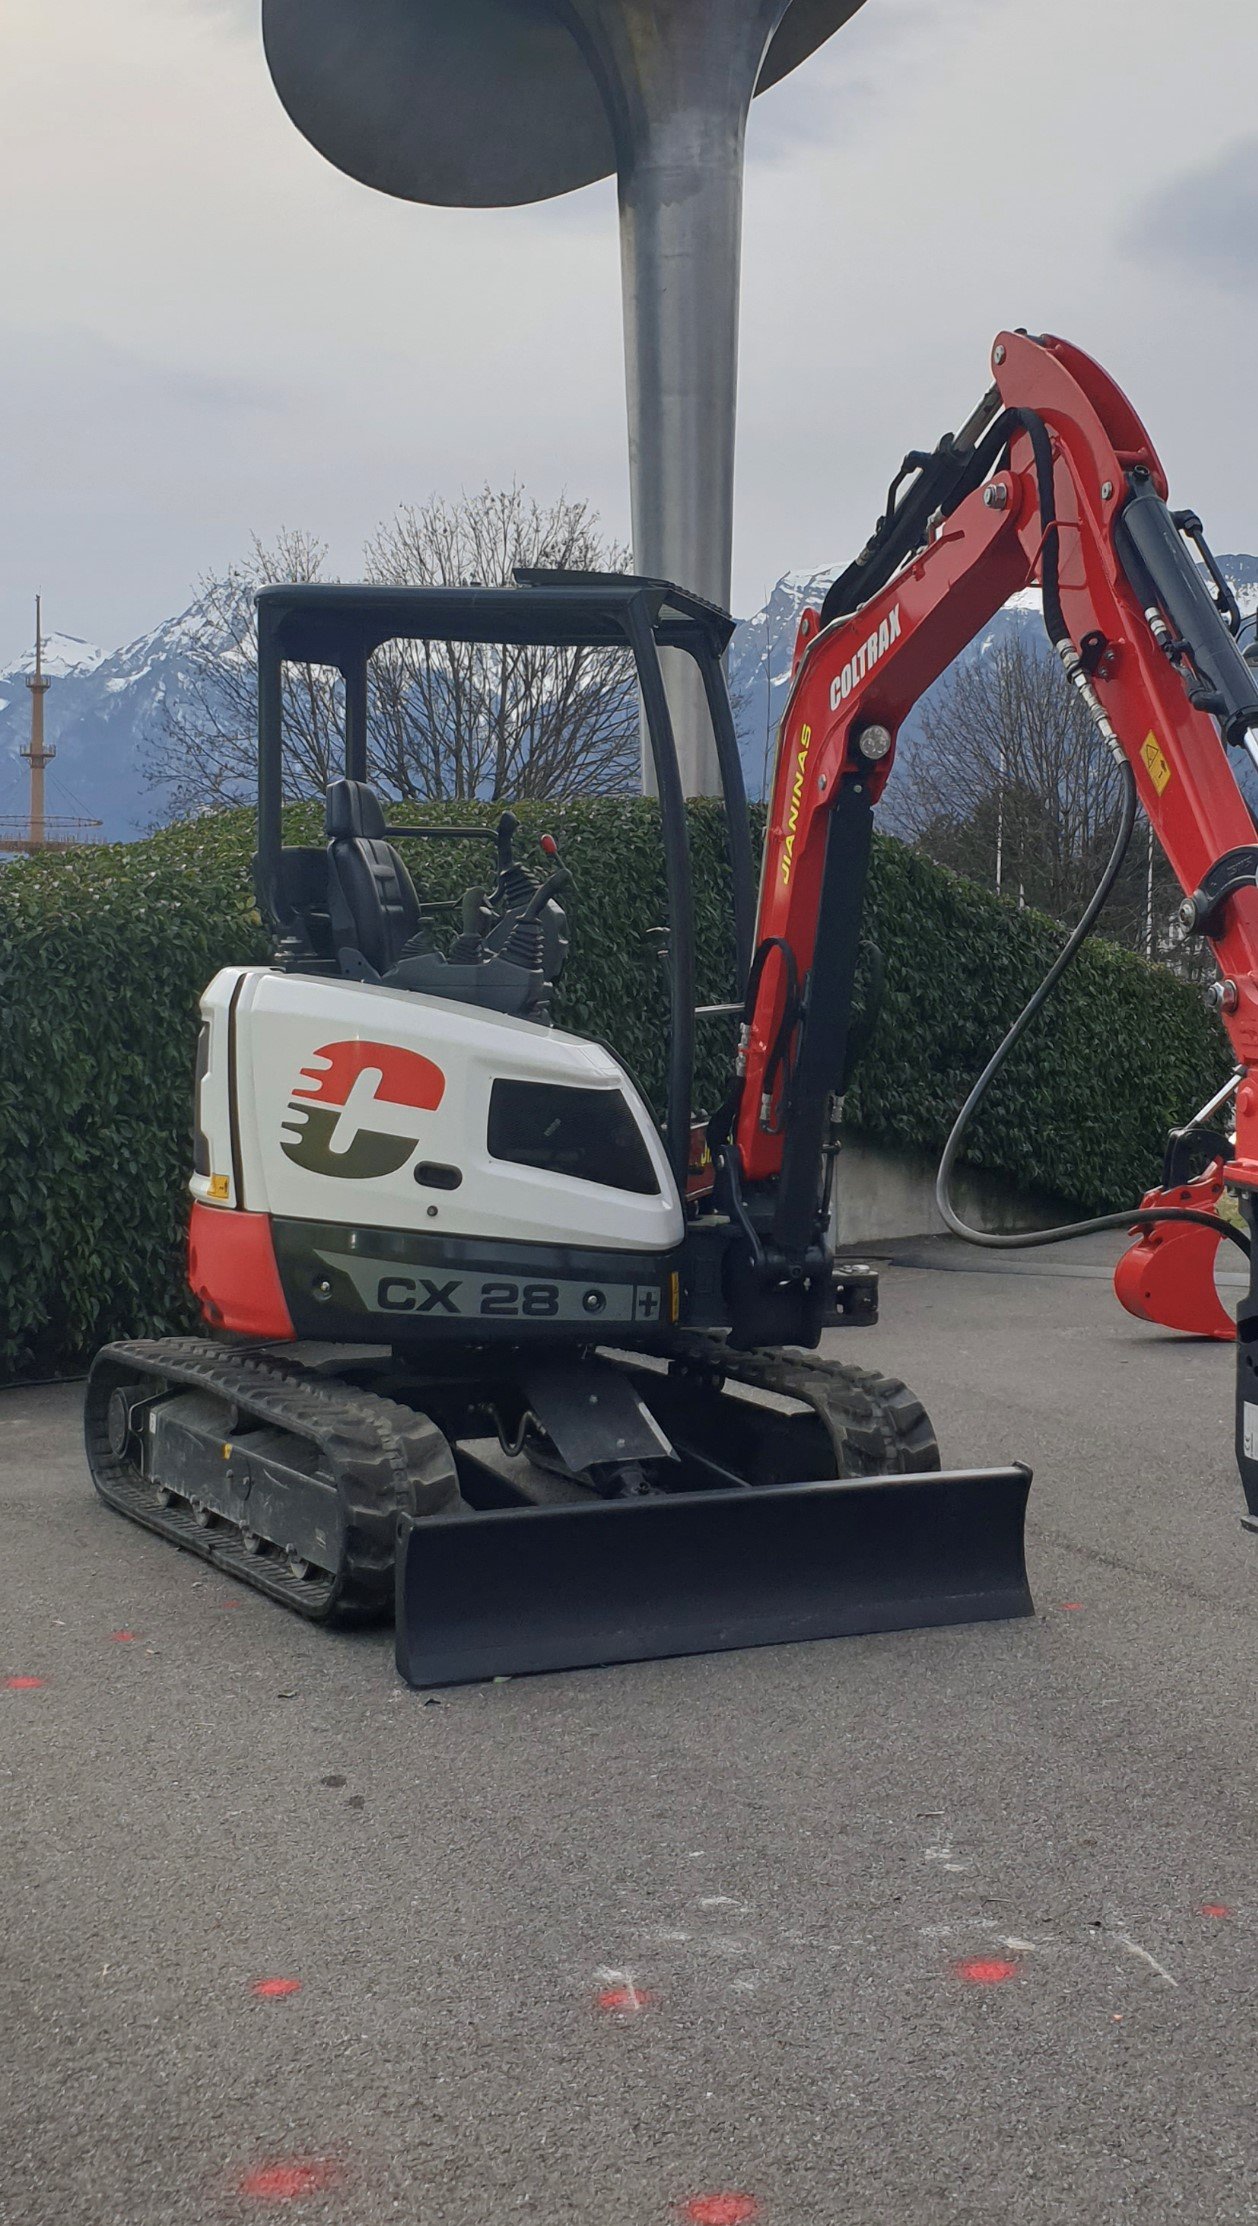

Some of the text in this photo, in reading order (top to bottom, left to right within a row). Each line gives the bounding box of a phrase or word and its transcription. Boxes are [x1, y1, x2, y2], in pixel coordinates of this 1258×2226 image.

[829, 603, 901, 711] COLTRAX
[782, 723, 812, 884] JIANINAS
[377, 1276, 560, 1316] CX 28
